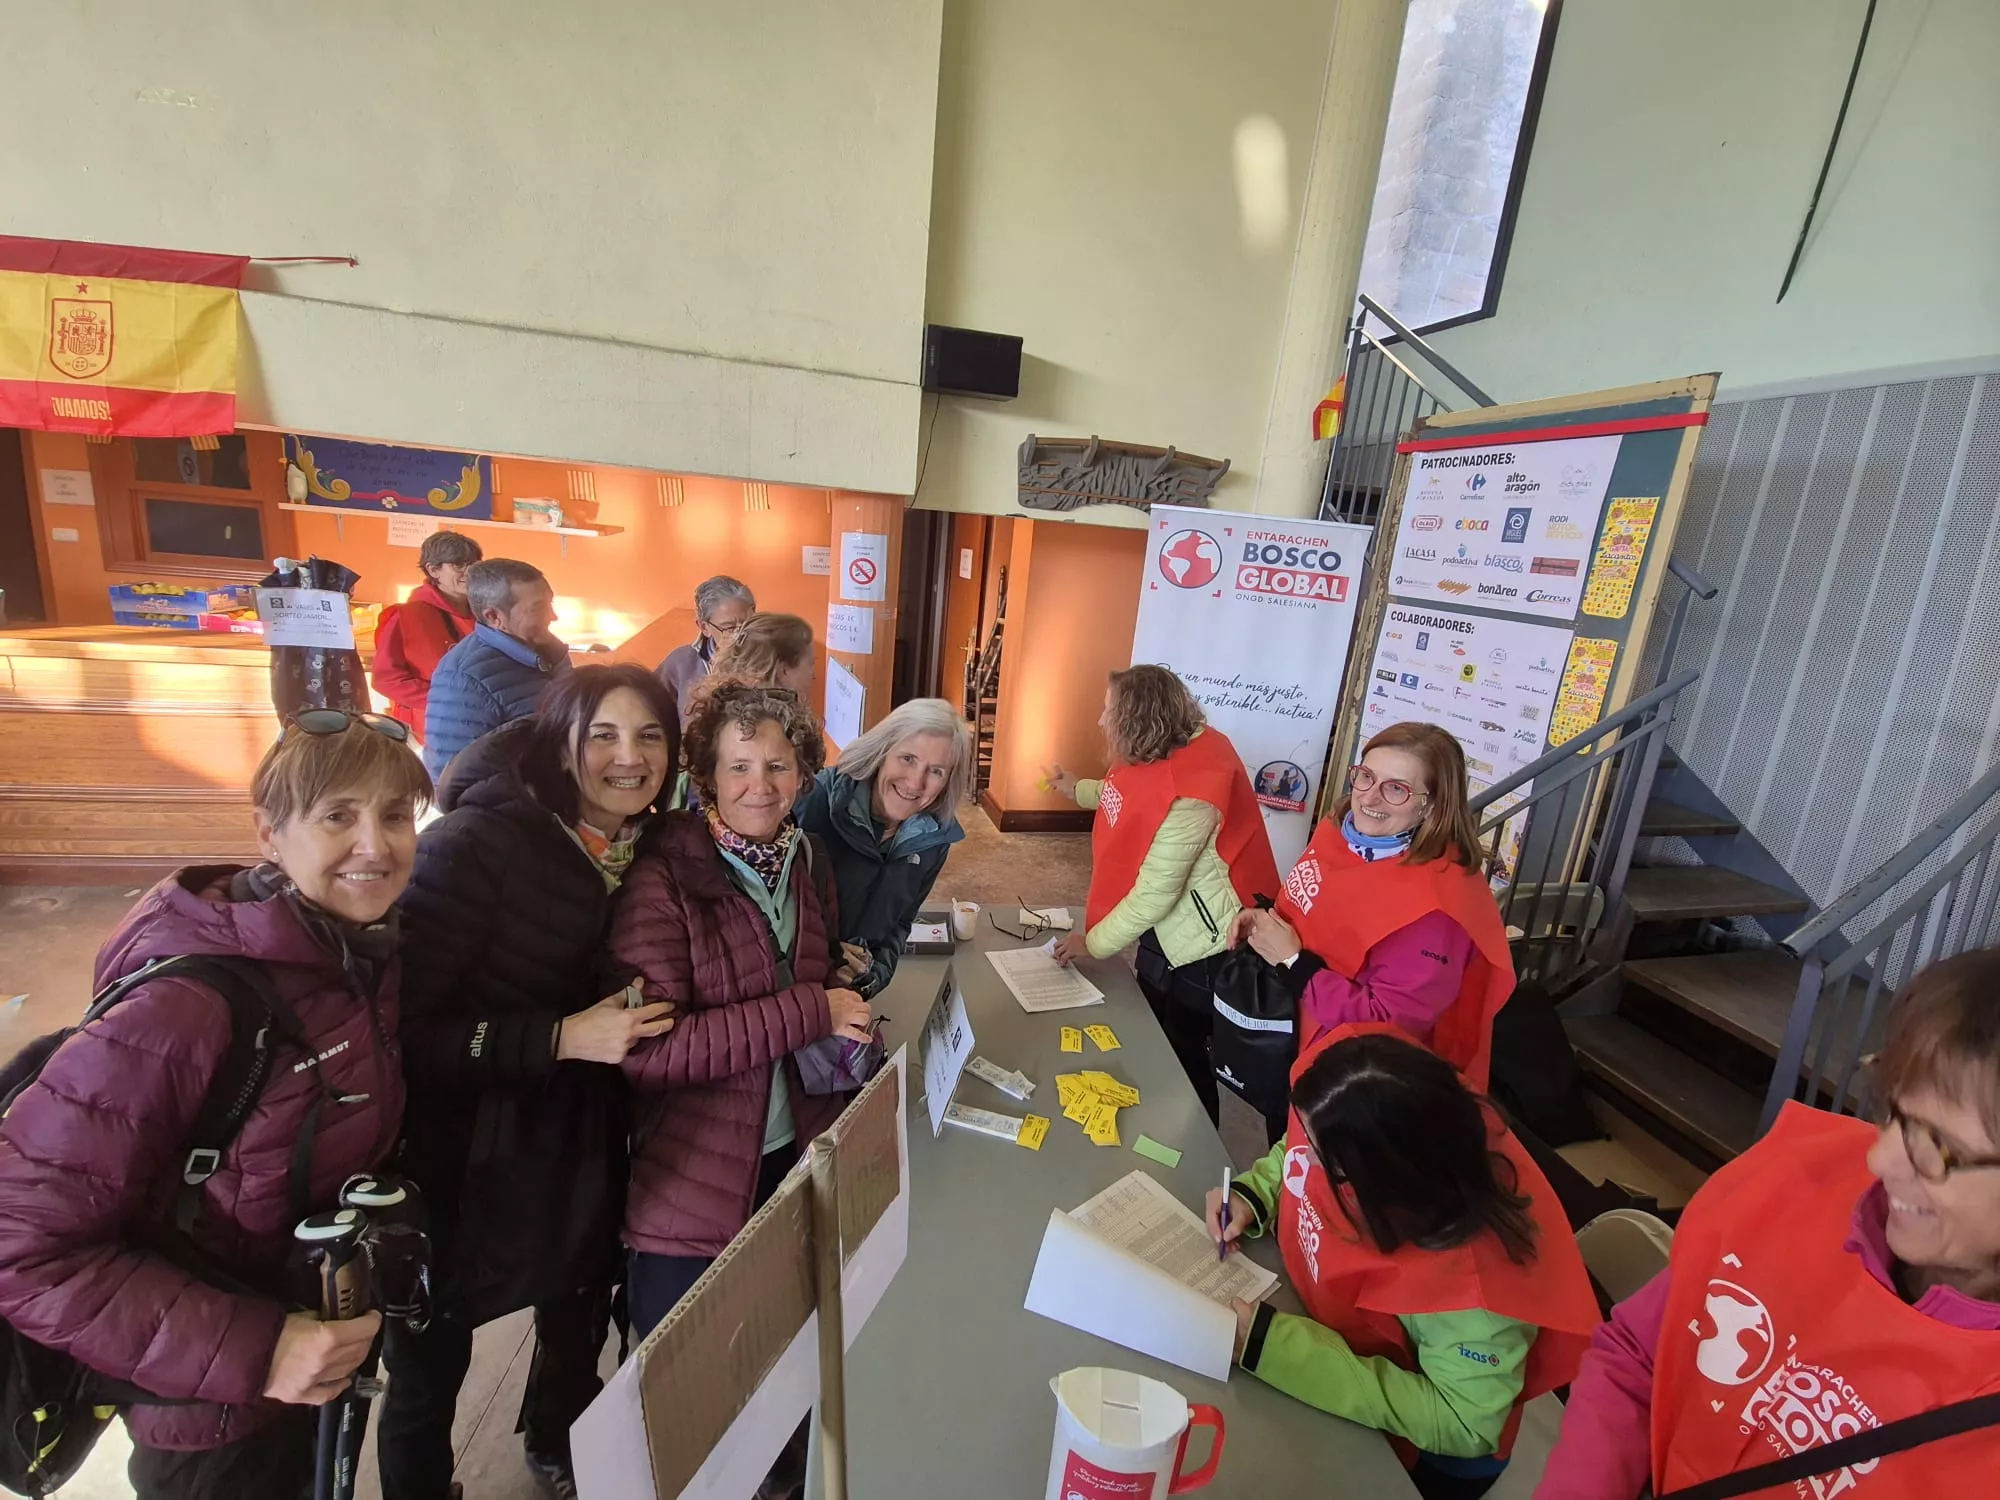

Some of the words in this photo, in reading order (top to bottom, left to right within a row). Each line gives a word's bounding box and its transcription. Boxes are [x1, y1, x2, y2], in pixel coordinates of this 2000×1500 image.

[51, 397, 112, 421] ¡VAMOS!
[1421, 453, 1516, 470] PATROCINADORES:
[1506, 472, 1526, 482] alto
[1504, 480, 1540, 494] aragón
[1549, 515, 1568, 523] RODI
[1247, 530, 1329, 548] ENTARACHEN
[1242, 544, 1342, 572] BOSCO
[1405, 547, 1437, 560] LACASA
[1442, 556, 1478, 565] podoactiva
[1484, 554, 1521, 569] blasco
[1237, 568, 1345, 601] GLOBAL
[1235, 593, 1264, 605] ONGD
[1267, 596, 1317, 610] SALESIANA
[1390, 610, 1475, 635] COLABORADORES:
[1203, 673, 1241, 689] mundo
[1246, 681, 1271, 696] más
[470, 1021, 488, 1059] altus
[294, 1040, 349, 1073] MAMMUT
